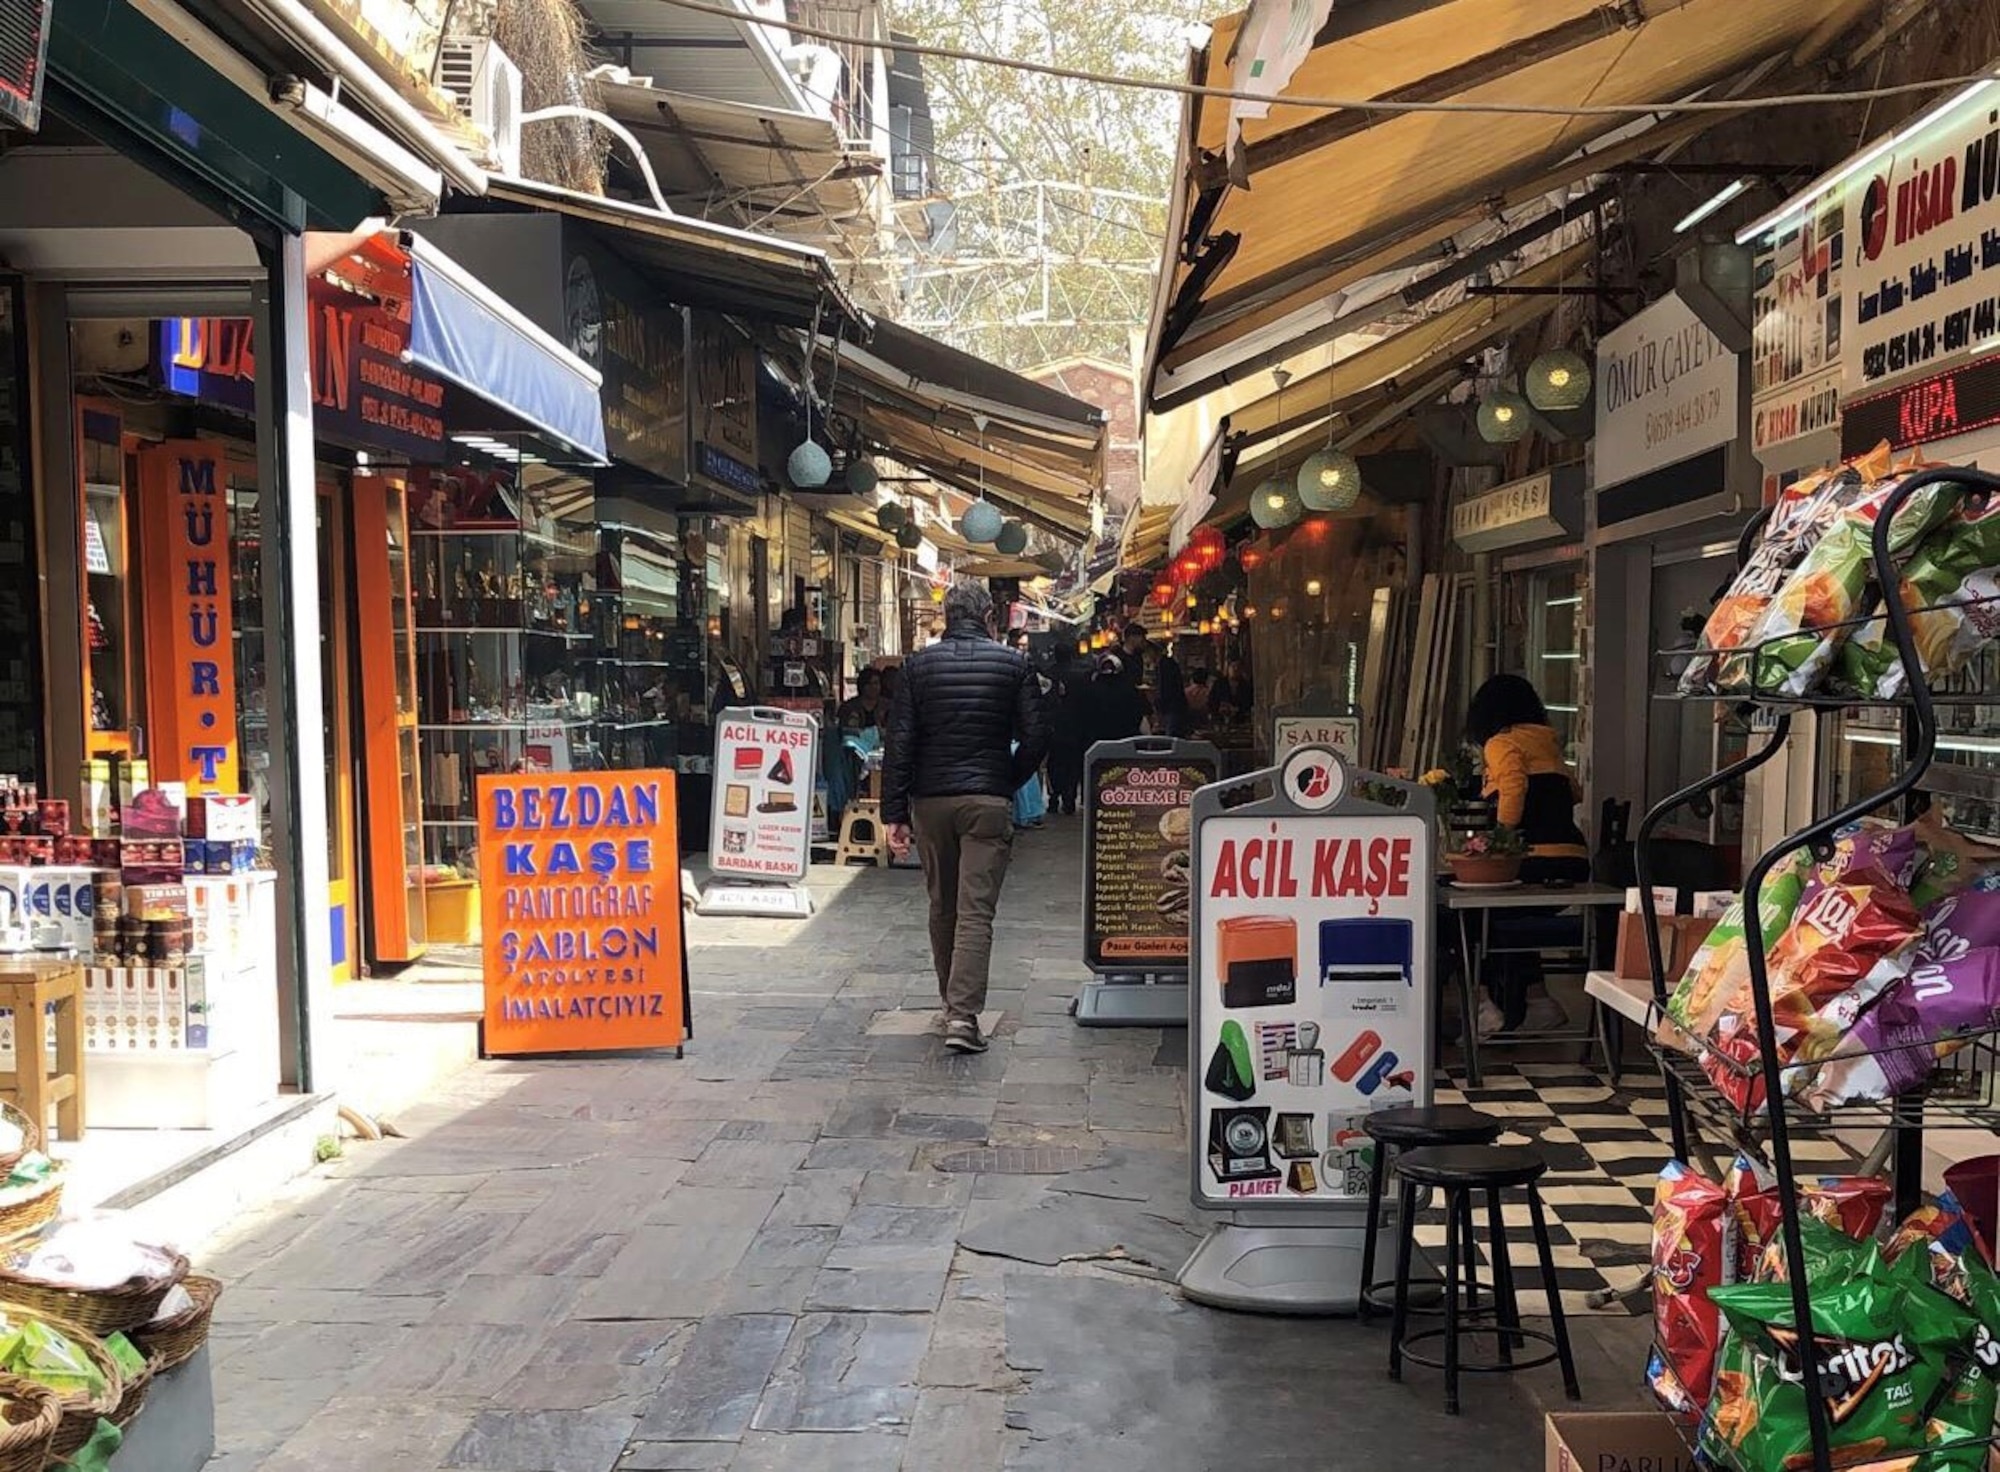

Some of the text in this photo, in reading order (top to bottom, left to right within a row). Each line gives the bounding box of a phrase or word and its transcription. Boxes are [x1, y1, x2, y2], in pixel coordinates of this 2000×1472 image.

[1961, 109, 2000, 212] MÜ
[1606, 333, 1658, 413] ÖMÜR
[1900, 378, 1958, 440] KUPA
[723, 724, 810, 748] ACİL KAŞE
[1101, 787, 1177, 805] GÖZLEME
[1127, 767, 1180, 786] ÖMÜR
[494, 783, 660, 831] BEZDAN
[504, 839, 653, 884] KAŞE
[717, 856, 799, 873] BARDAK BASKI
[1210, 821, 1412, 916] ACİL KAŞE
[505, 884, 655, 920] PANTOGRAF
[502, 926, 659, 973] ŞABLON
[503, 993, 664, 1022] İMALATÇIYIZ
[1229, 1180, 1282, 1198] PLAKET
